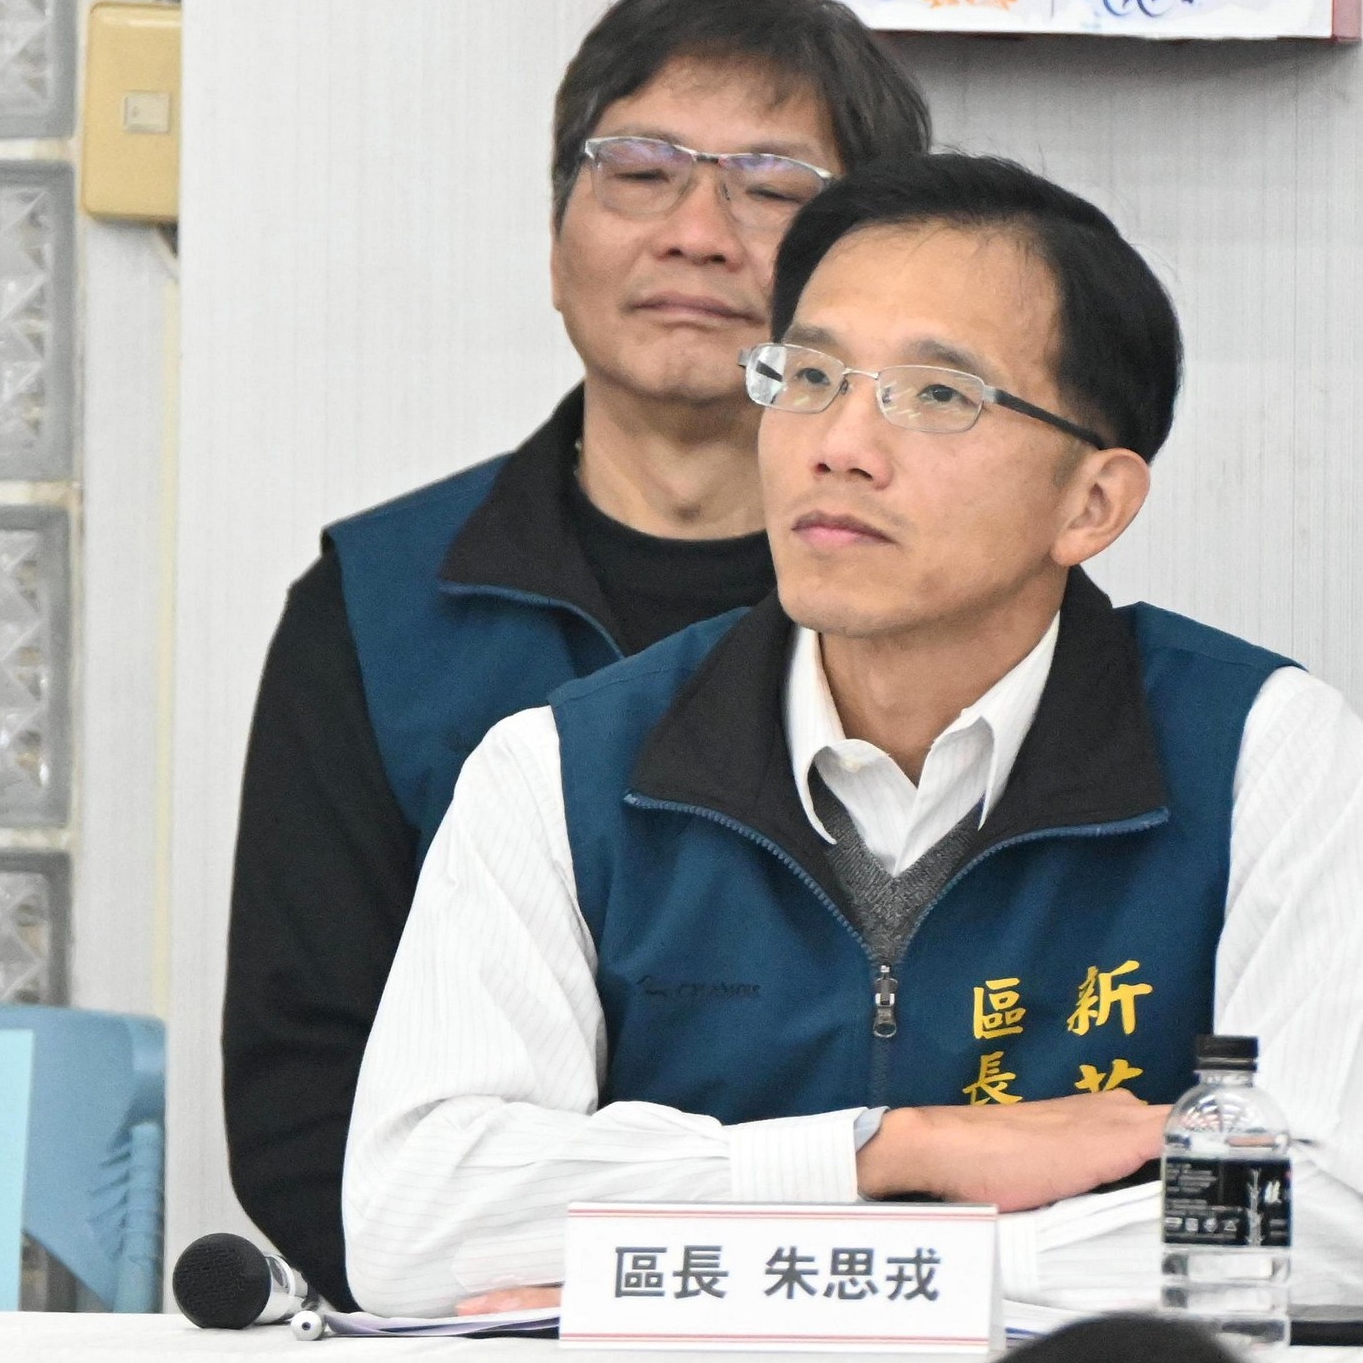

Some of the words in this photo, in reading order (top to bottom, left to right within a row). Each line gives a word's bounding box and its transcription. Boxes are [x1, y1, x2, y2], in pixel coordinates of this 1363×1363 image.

[962, 977, 1027, 1105] 區長
[614, 1245, 729, 1299] 區長
[764, 1245, 941, 1301] 朱思戎
